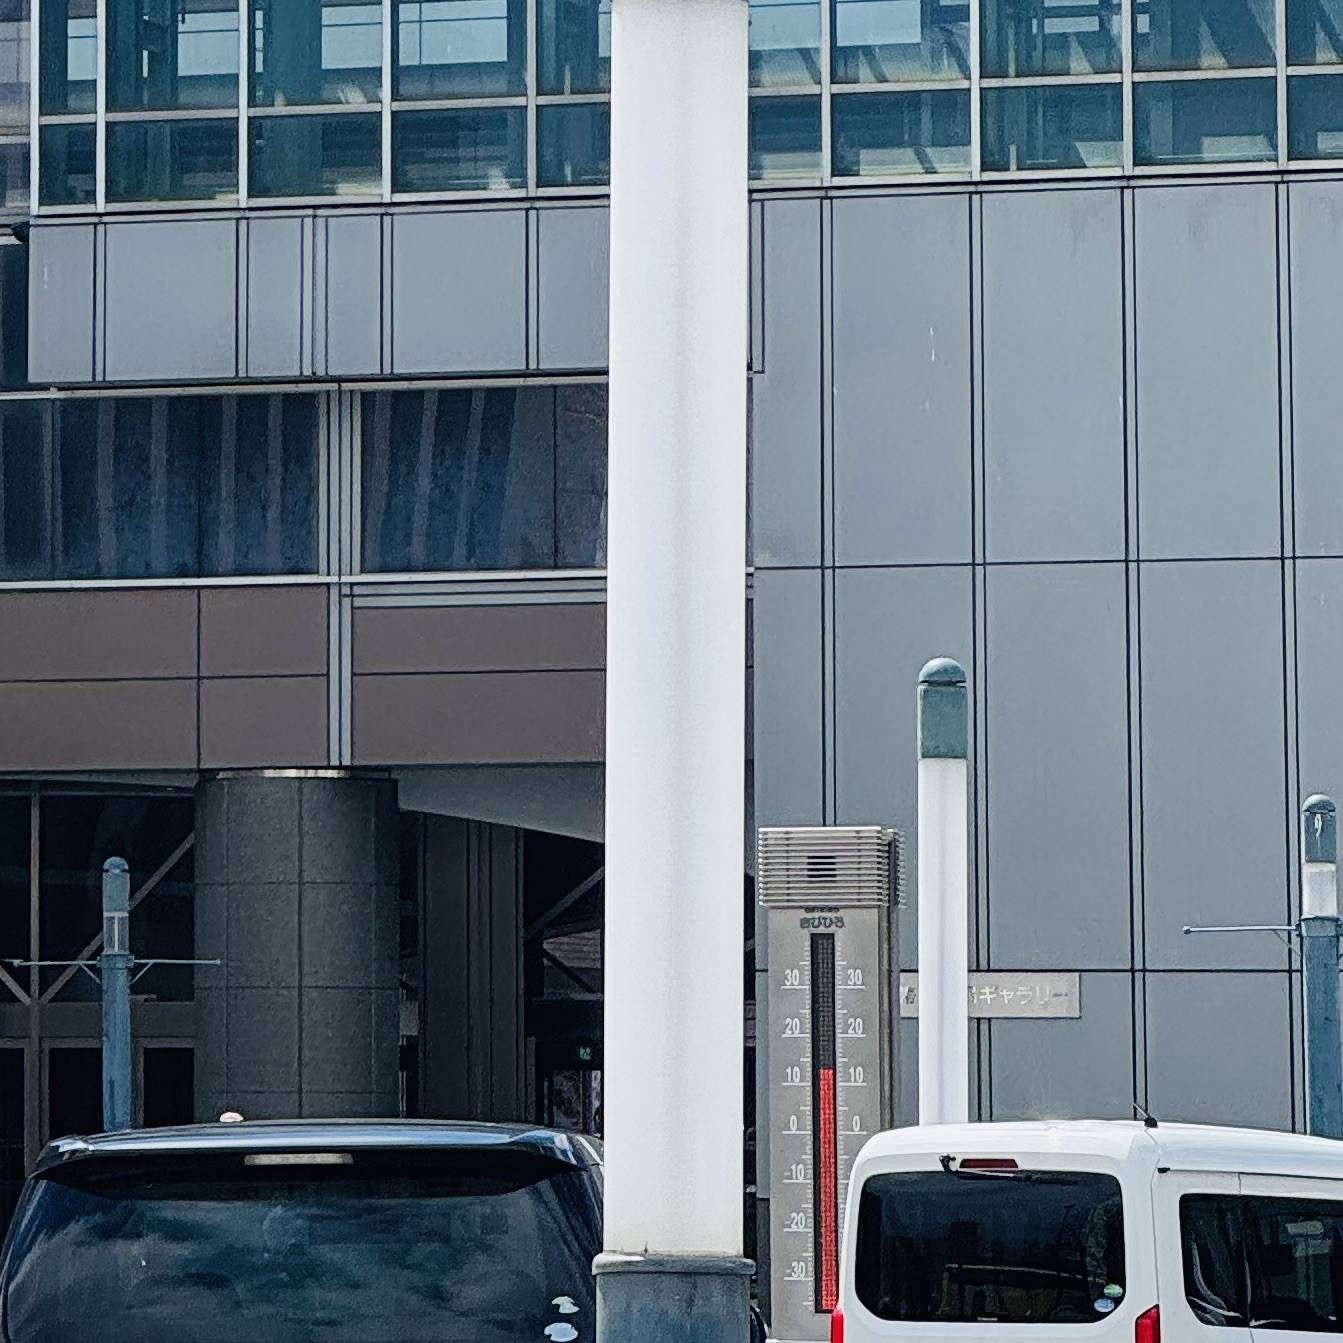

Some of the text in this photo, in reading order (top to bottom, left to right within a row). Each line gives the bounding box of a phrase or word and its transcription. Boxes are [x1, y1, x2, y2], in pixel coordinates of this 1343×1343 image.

[784, 968, 800, 986] 30
[847, 968, 863, 985] 30
[784, 1017, 801, 1035] 20
[847, 1017, 863, 1035] 20
[785, 1066, 801, 1083] 10
[849, 1066, 864, 1083] 10
[789, 1114, 798, 1132] 0
[852, 1114, 861, 1132] 0
[784, 1163, 805, 1181] -10
[785, 1212, 806, 1229] -20
[785, 1261, 806, 1279] -30
